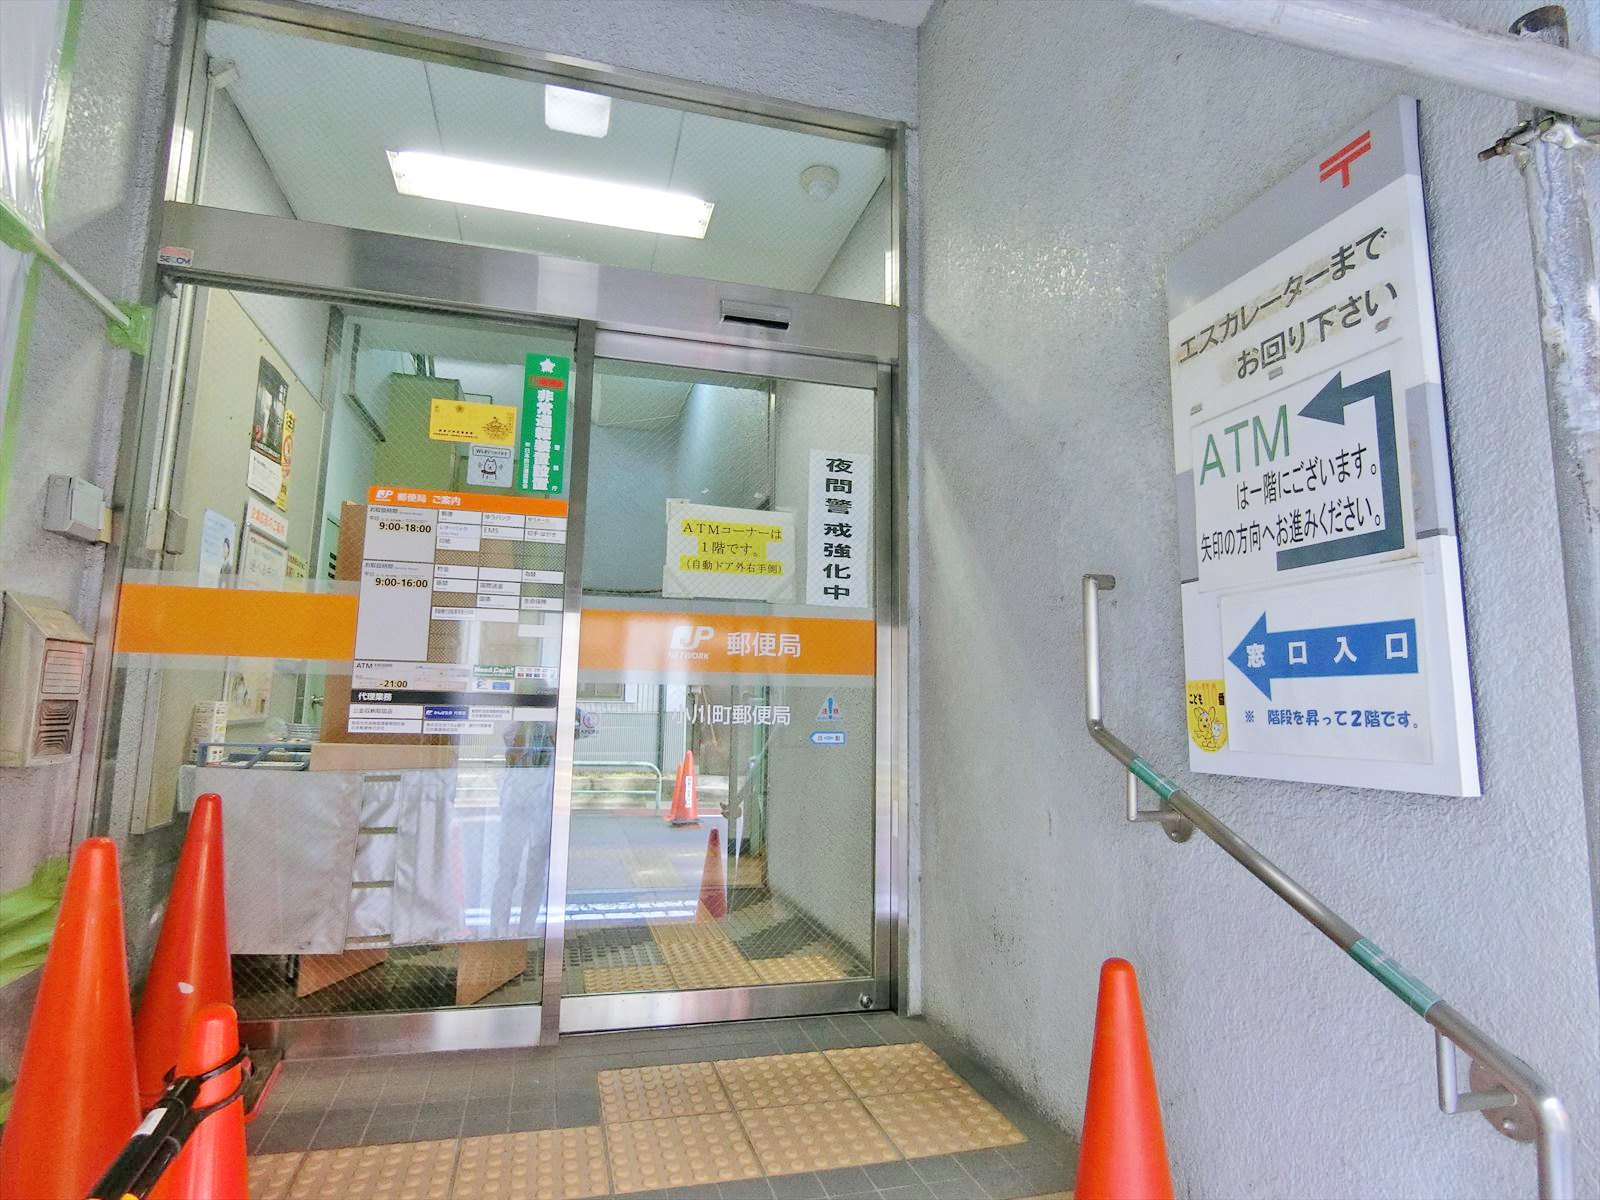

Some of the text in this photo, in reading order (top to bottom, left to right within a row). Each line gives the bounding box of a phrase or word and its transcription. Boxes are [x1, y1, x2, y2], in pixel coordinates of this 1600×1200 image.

[1178, 226, 1388, 364] エスカレーターまで
[1237, 282, 1398, 380] お回り下さい
[1200, 404, 1290, 486] ATM
[1236, 443, 1378, 510] は一階にございます。
[397, 493, 427, 503] 郵便局
[432, 495, 461, 506] ご案内
[379, 521, 432, 534] 9:00-18:00
[483, 527, 499, 535] EMS
[682, 522, 783, 540] ATMコーナーは
[822, 457, 854, 601] 夜間警戒強化中
[1200, 495, 1382, 563] 矢印の方向へお進みください。
[702, 541, 758, 558] 1階です。
[685, 560, 783, 575] （自動ドア外右手側）
[375, 577, 428, 588] 9:00-16:00
[727, 631, 801, 657] 郵便局
[1246, 632, 1409, 669] 窓口入口
[667, 651, 711, 660] NETWORK
[671, 703, 791, 725] 小川町郵便局
[1267, 709, 1419, 729] 階段を昇って2階です。
